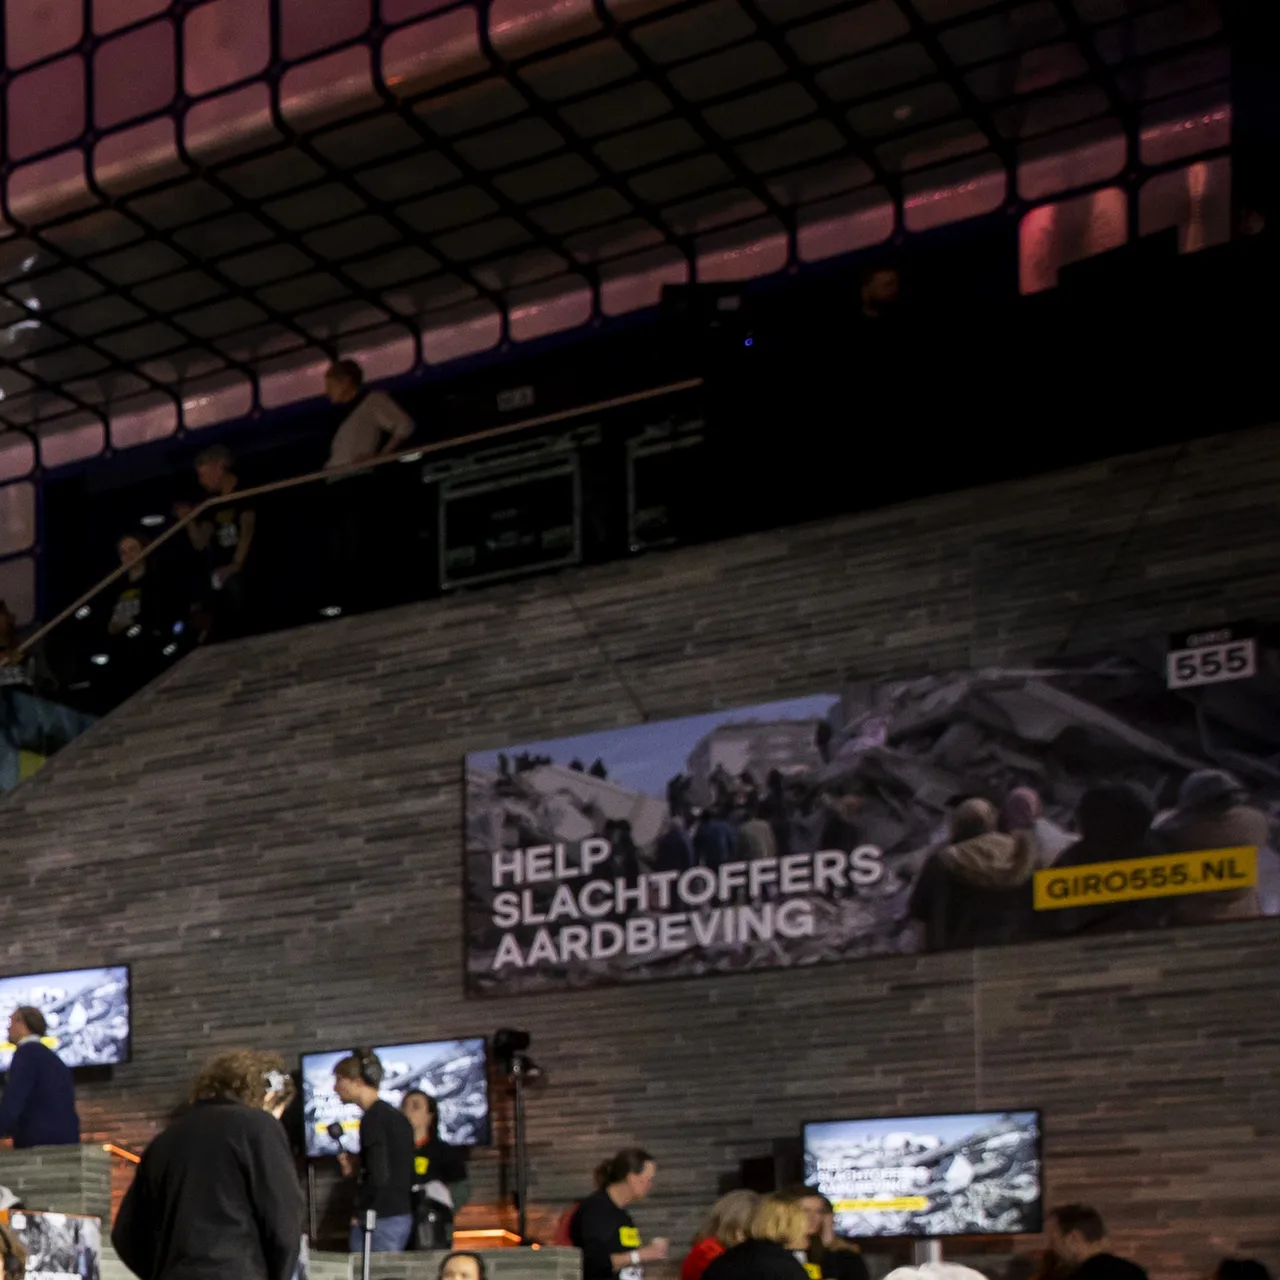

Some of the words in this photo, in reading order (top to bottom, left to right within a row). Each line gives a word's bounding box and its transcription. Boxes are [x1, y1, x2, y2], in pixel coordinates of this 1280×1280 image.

[1177, 648, 1247, 681] 555
[491, 838, 612, 888] HELP
[491, 844, 884, 930] SLACHTOFFERS
[1044, 858, 1247, 902] GIRO555.NL
[492, 897, 815, 971] AARDBEVING
